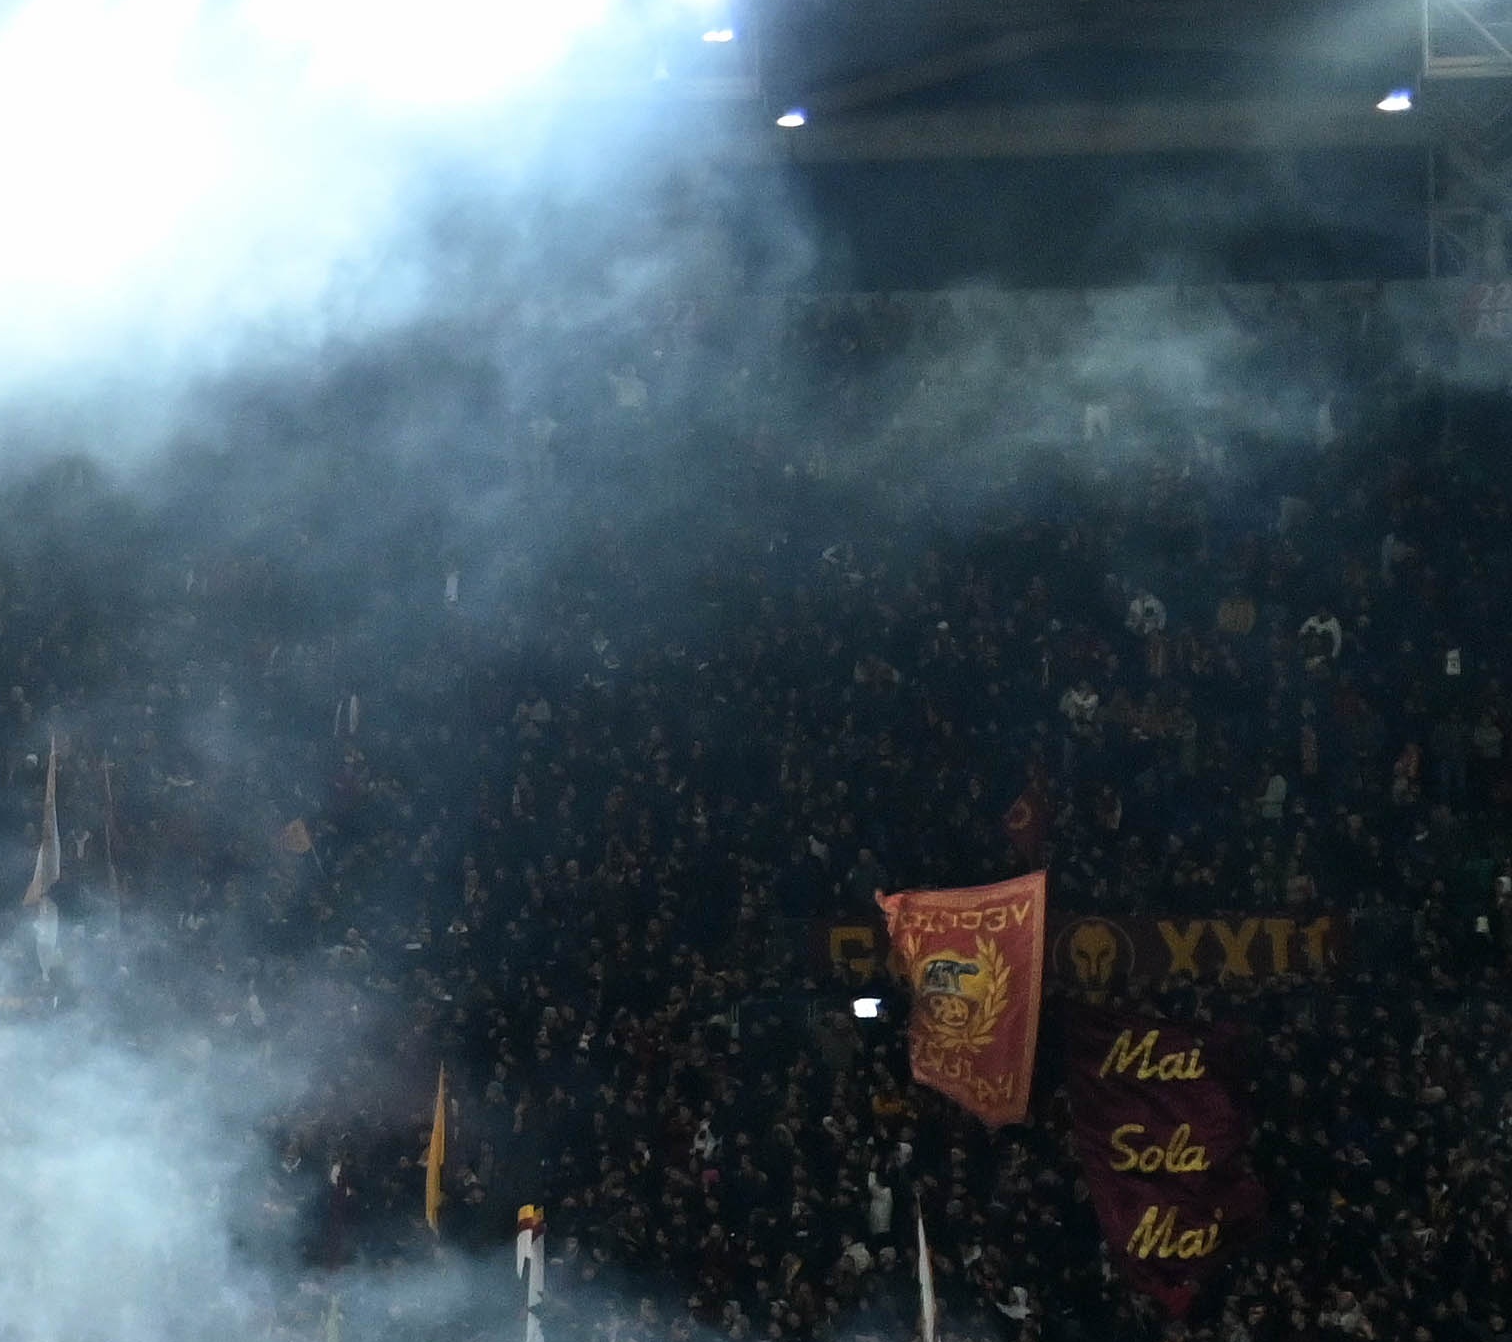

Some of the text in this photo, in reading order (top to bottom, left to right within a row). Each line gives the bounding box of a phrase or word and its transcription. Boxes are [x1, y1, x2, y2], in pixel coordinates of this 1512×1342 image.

[1099, 1029, 1205, 1080] Mai
[1110, 1123, 1210, 1172] Sola
[1126, 1205, 1224, 1259] Mai
